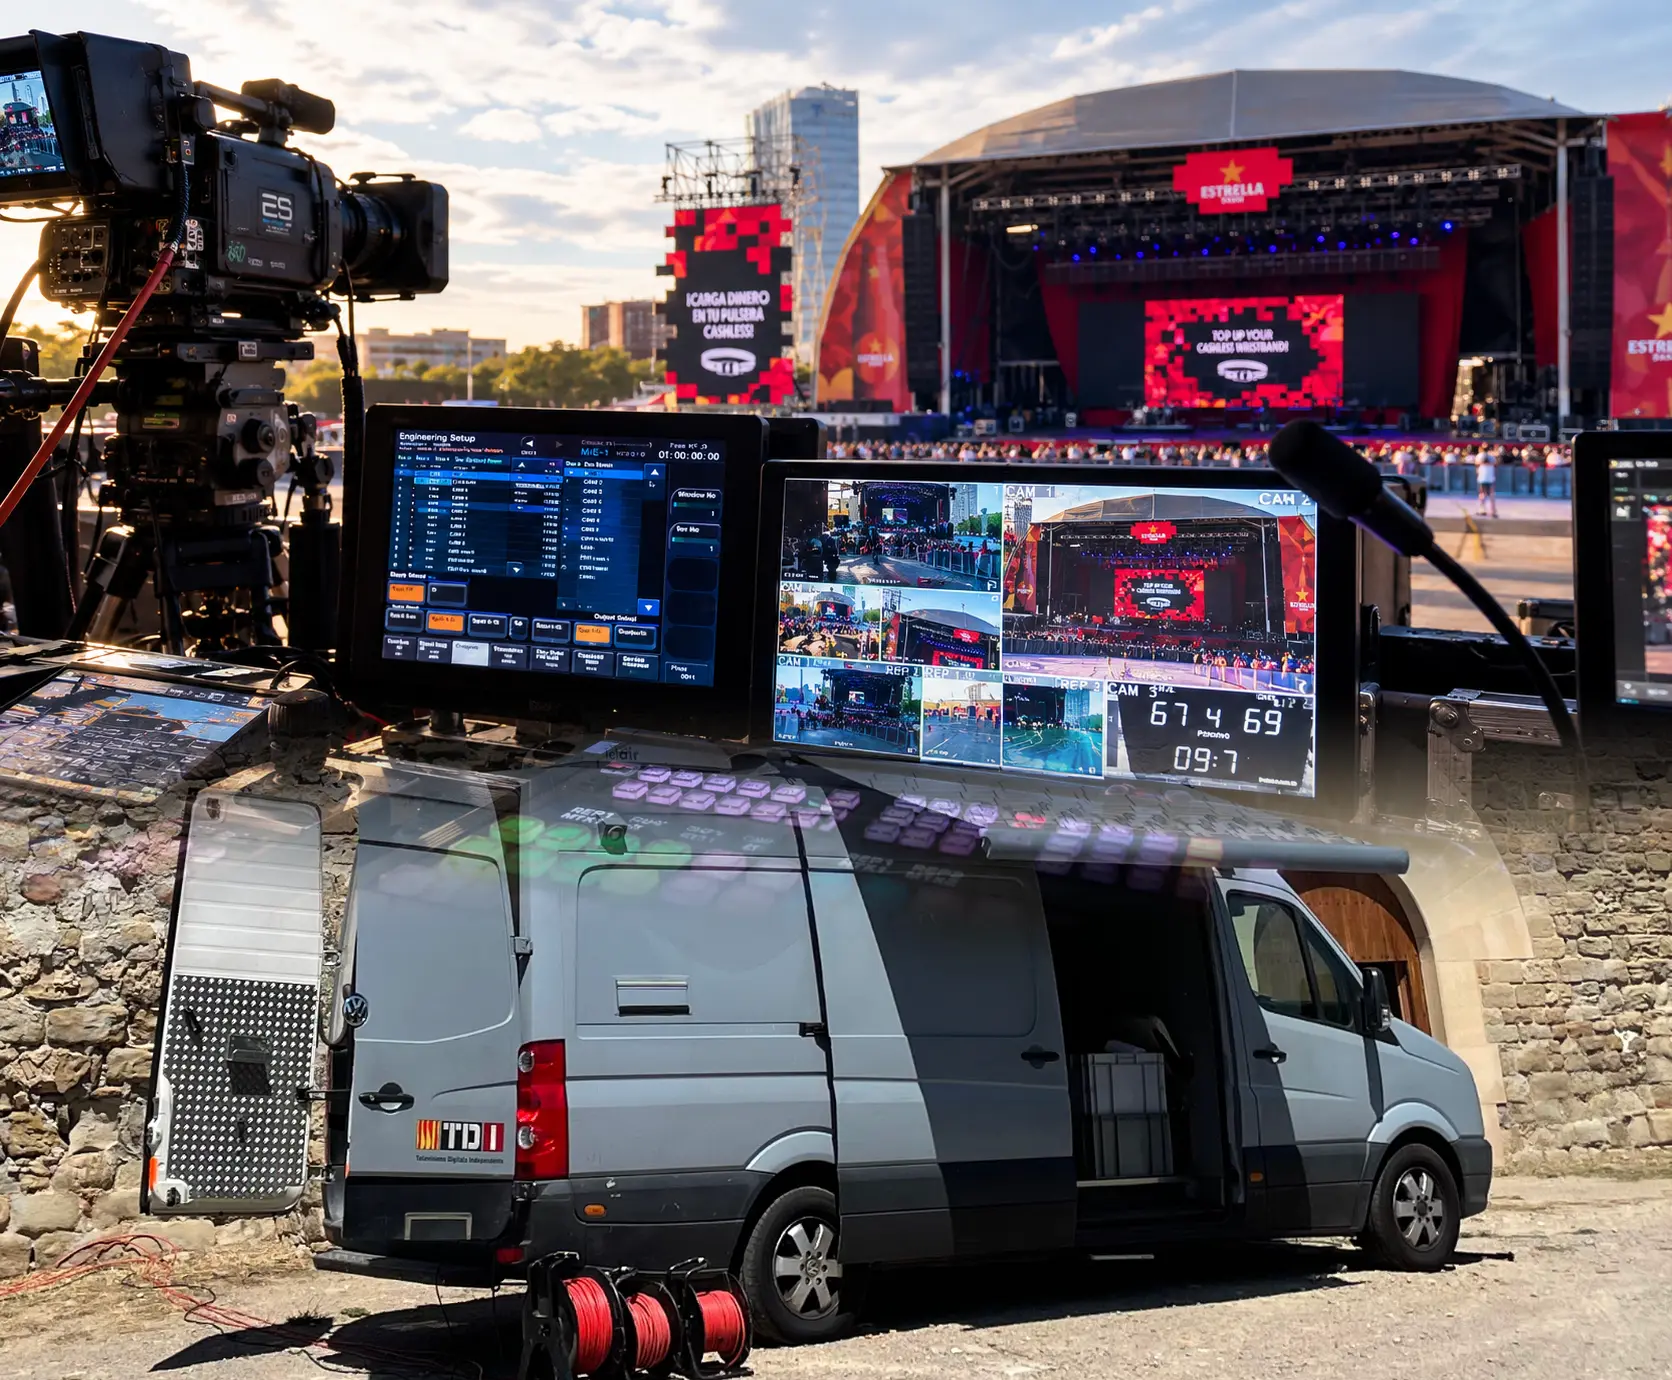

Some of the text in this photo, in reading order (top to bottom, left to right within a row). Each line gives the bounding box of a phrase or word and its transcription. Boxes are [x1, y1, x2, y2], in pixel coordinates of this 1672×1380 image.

[1200, 182, 1264, 199] ESTRELLA
[727, 290, 771, 306] DINERO
[692, 307, 765, 324] EN TU PULSERA
[703, 324, 755, 339] CASHLESS!
[1211, 329, 1274, 342] TOP UP YOUR
[399, 432, 476, 443] Engineering Setup
[1006, 485, 1035, 499] CAM
[1107, 682, 1139, 697] CAM
[1150, 701, 1189, 727] 67
[1206, 707, 1221, 728] 4
[1243, 708, 1283, 736] 69
